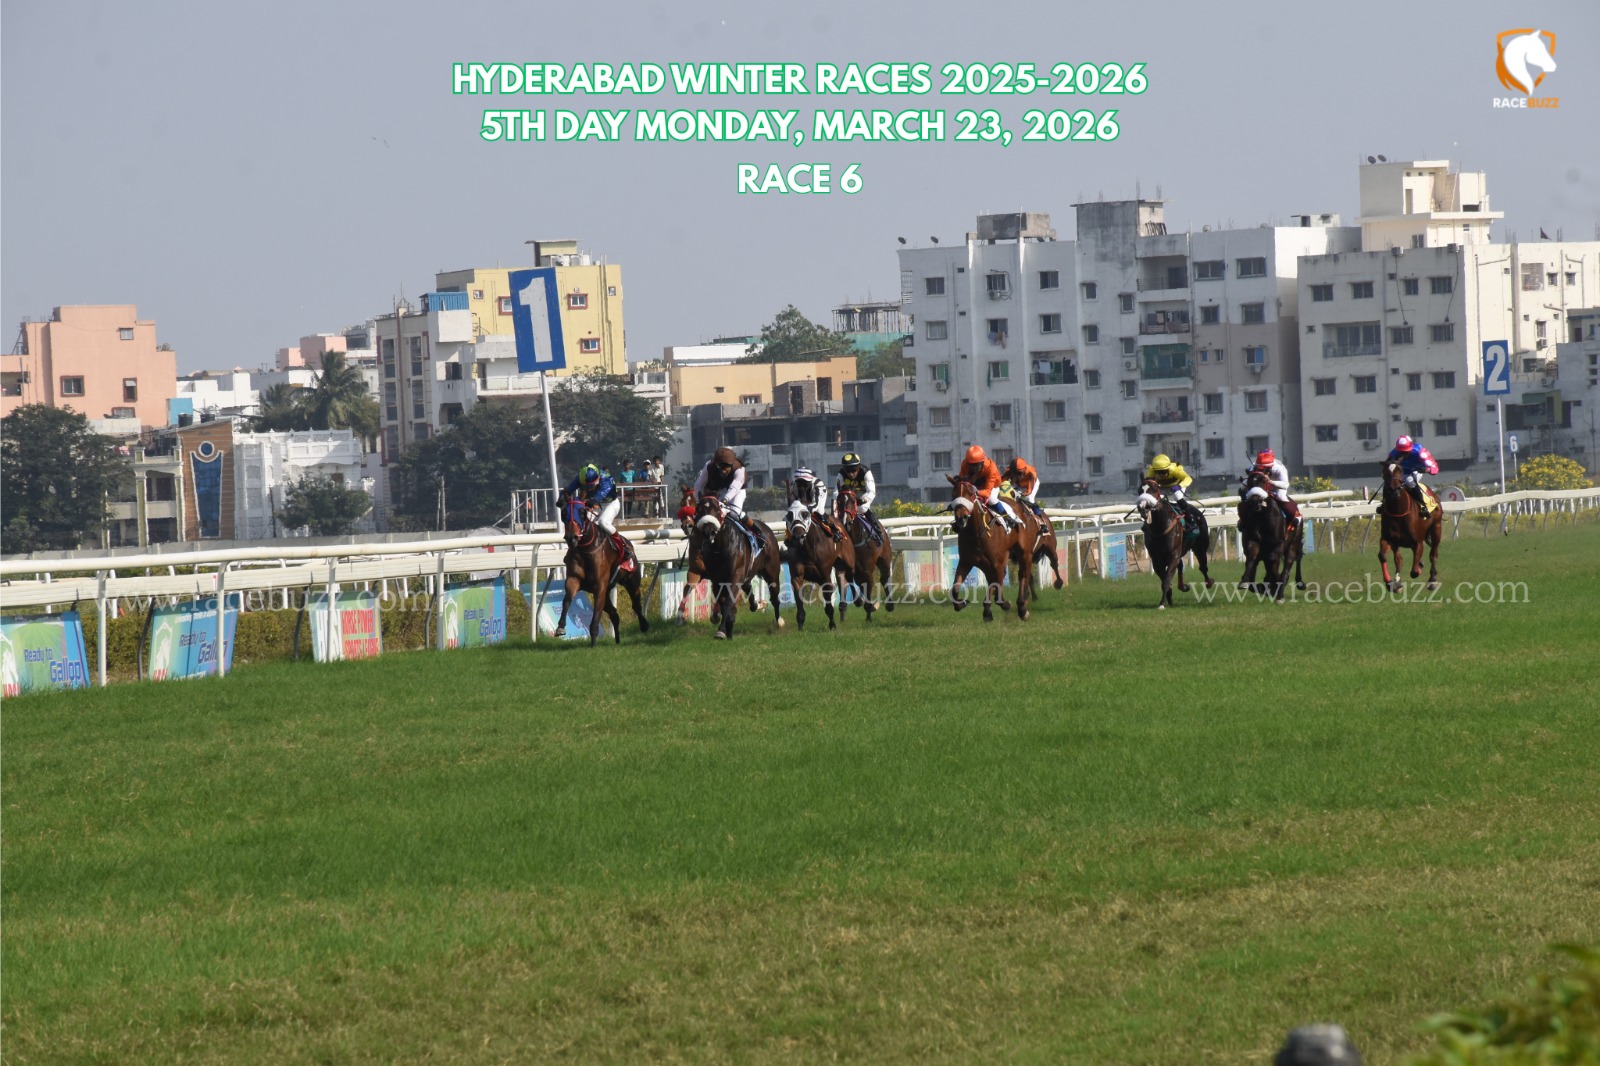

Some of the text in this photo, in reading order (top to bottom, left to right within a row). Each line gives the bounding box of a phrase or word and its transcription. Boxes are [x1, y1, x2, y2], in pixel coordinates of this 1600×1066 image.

[519, 276, 553, 363] 1
[1486, 344, 1507, 391] 2
[1509, 435, 1518, 452] 6
[463, 609, 478, 620] Ready
[480, 615, 502, 638] Gallop
[179, 632, 198, 648] Ready
[24, 646, 53, 664] Ready to
[49, 655, 82, 685] Gallop
